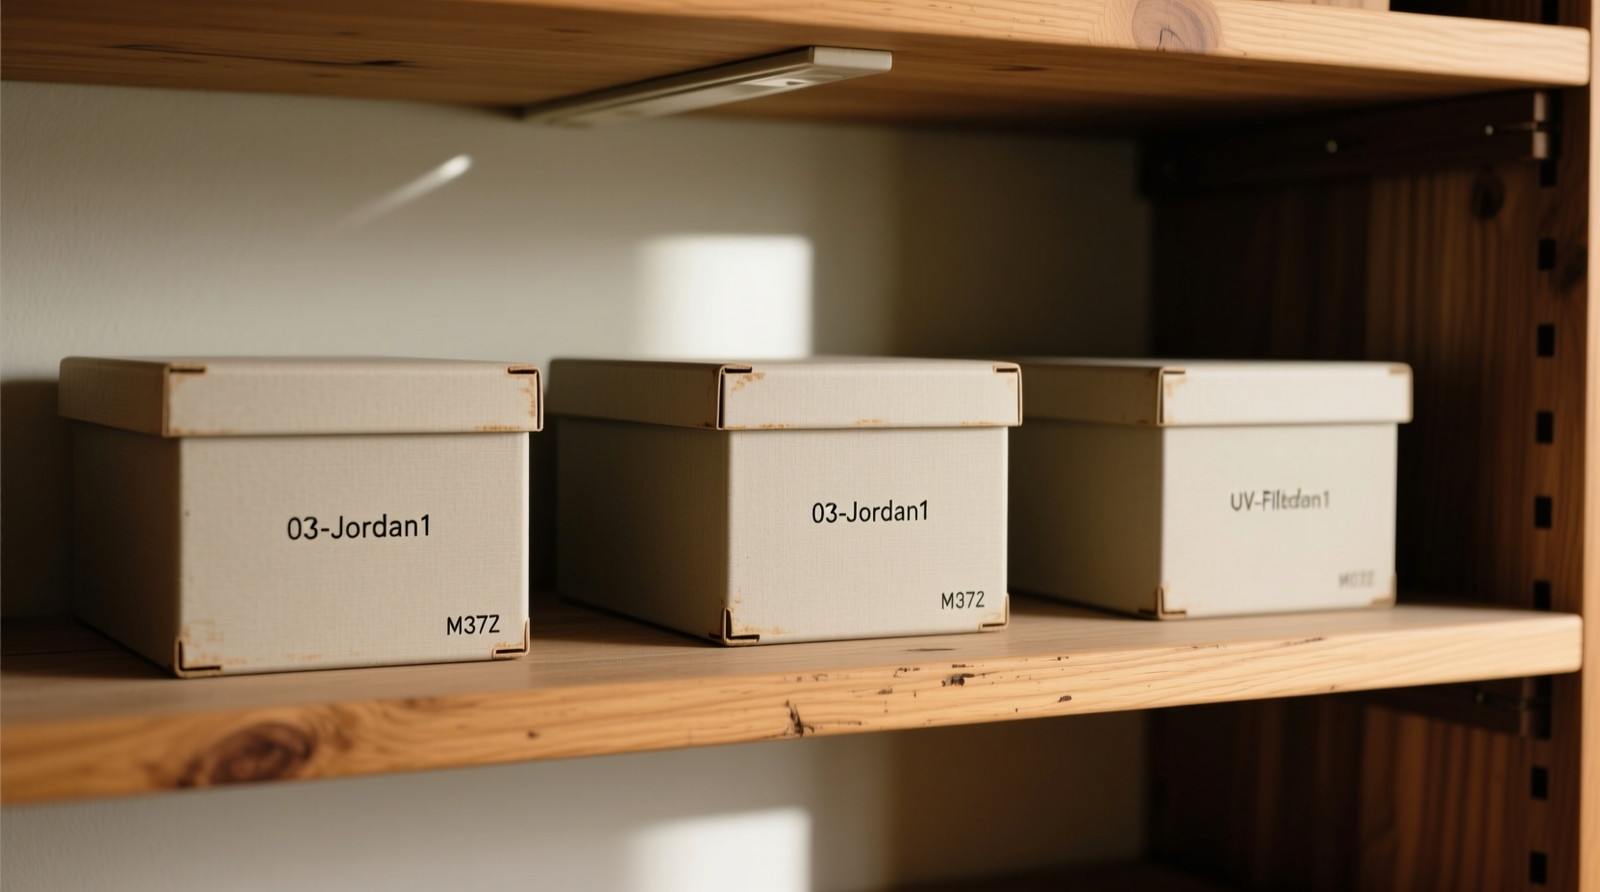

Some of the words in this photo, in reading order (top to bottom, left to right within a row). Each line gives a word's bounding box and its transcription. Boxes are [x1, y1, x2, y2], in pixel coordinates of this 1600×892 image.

[811, 498, 928, 524] 03-Jordan1
[286, 512, 430, 541] 03-Jordan1
[941, 590, 986, 610] M372
